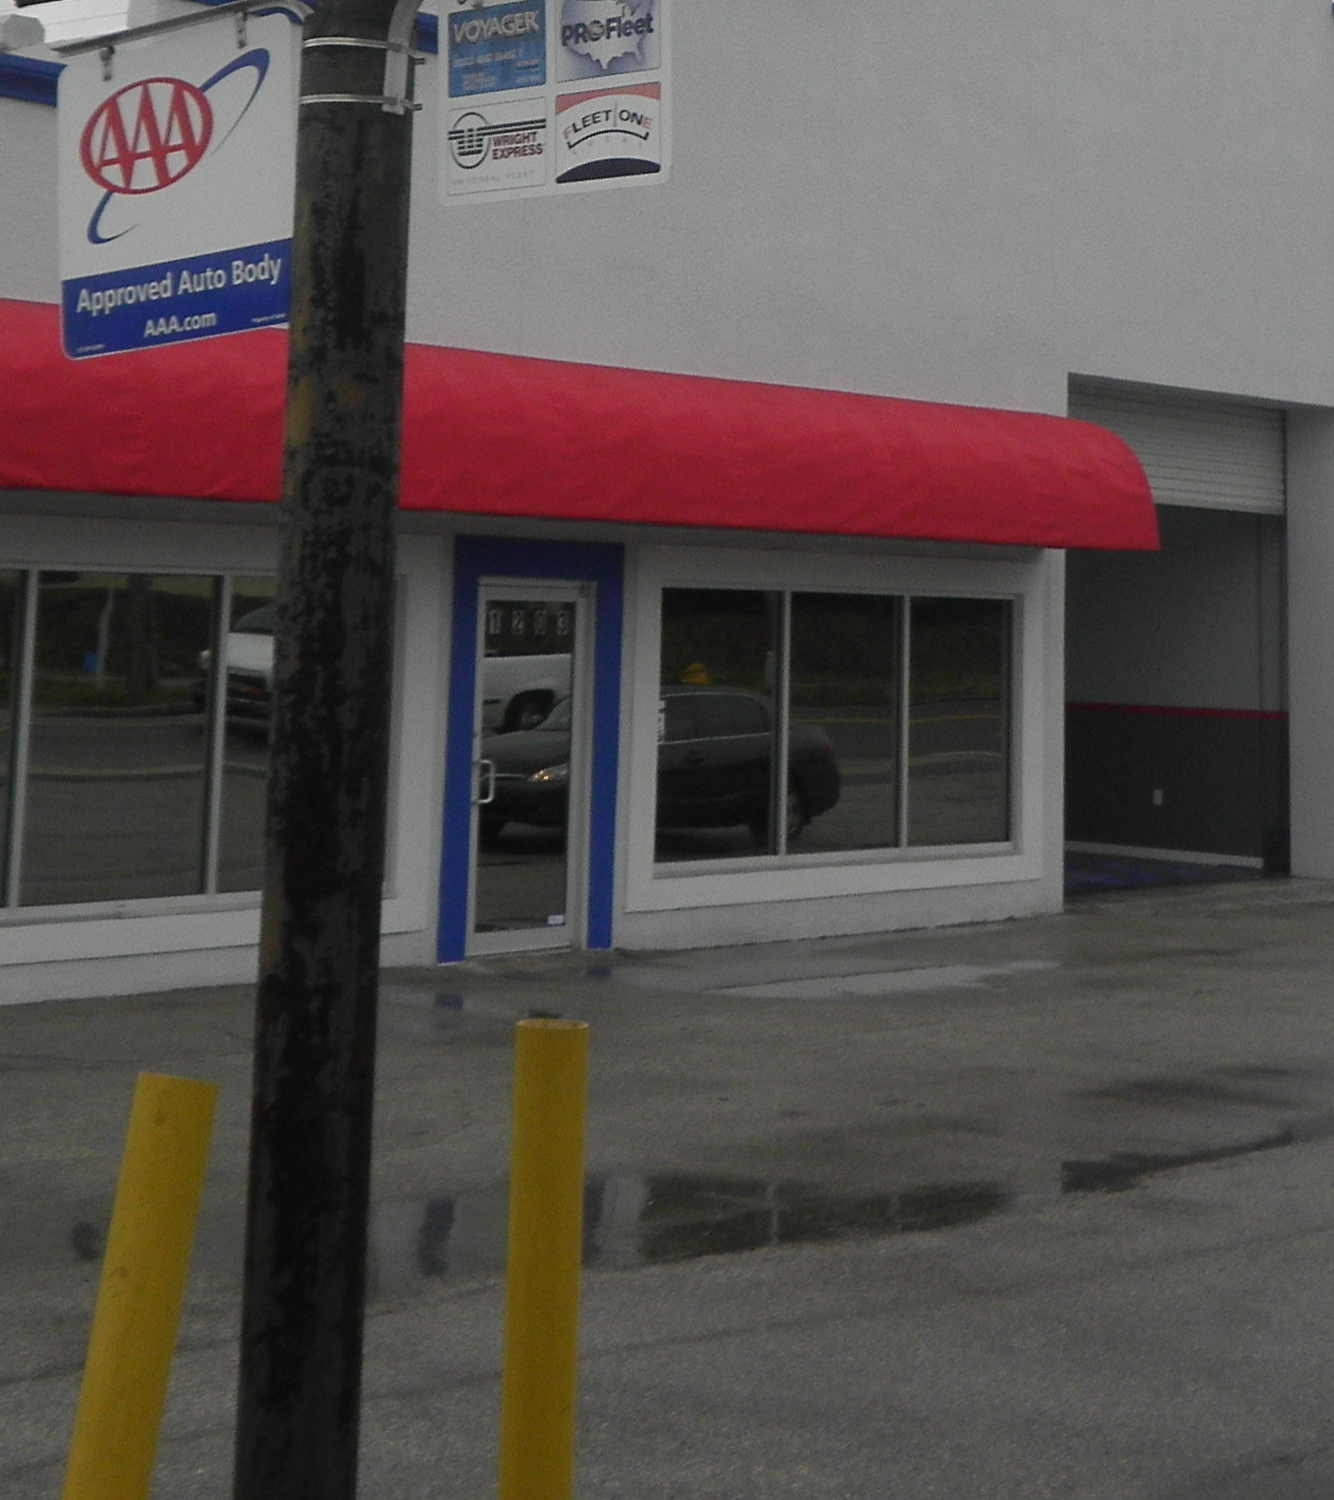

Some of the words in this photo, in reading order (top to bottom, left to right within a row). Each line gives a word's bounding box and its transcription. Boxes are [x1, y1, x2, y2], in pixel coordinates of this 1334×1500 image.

[453, 11, 541, 45] VOYAGER
[97, 80, 202, 192] AAA
[493, 131, 537, 147] WRIGHT
[562, 109, 613, 140] FLEET
[618, 109, 653, 130] ONE
[492, 143, 544, 160] EXPRESS
[75, 272, 172, 317] Approved
[177, 267, 227, 296] Auto
[231, 253, 282, 286] Body
[143, 312, 217, 338] AAA.com
